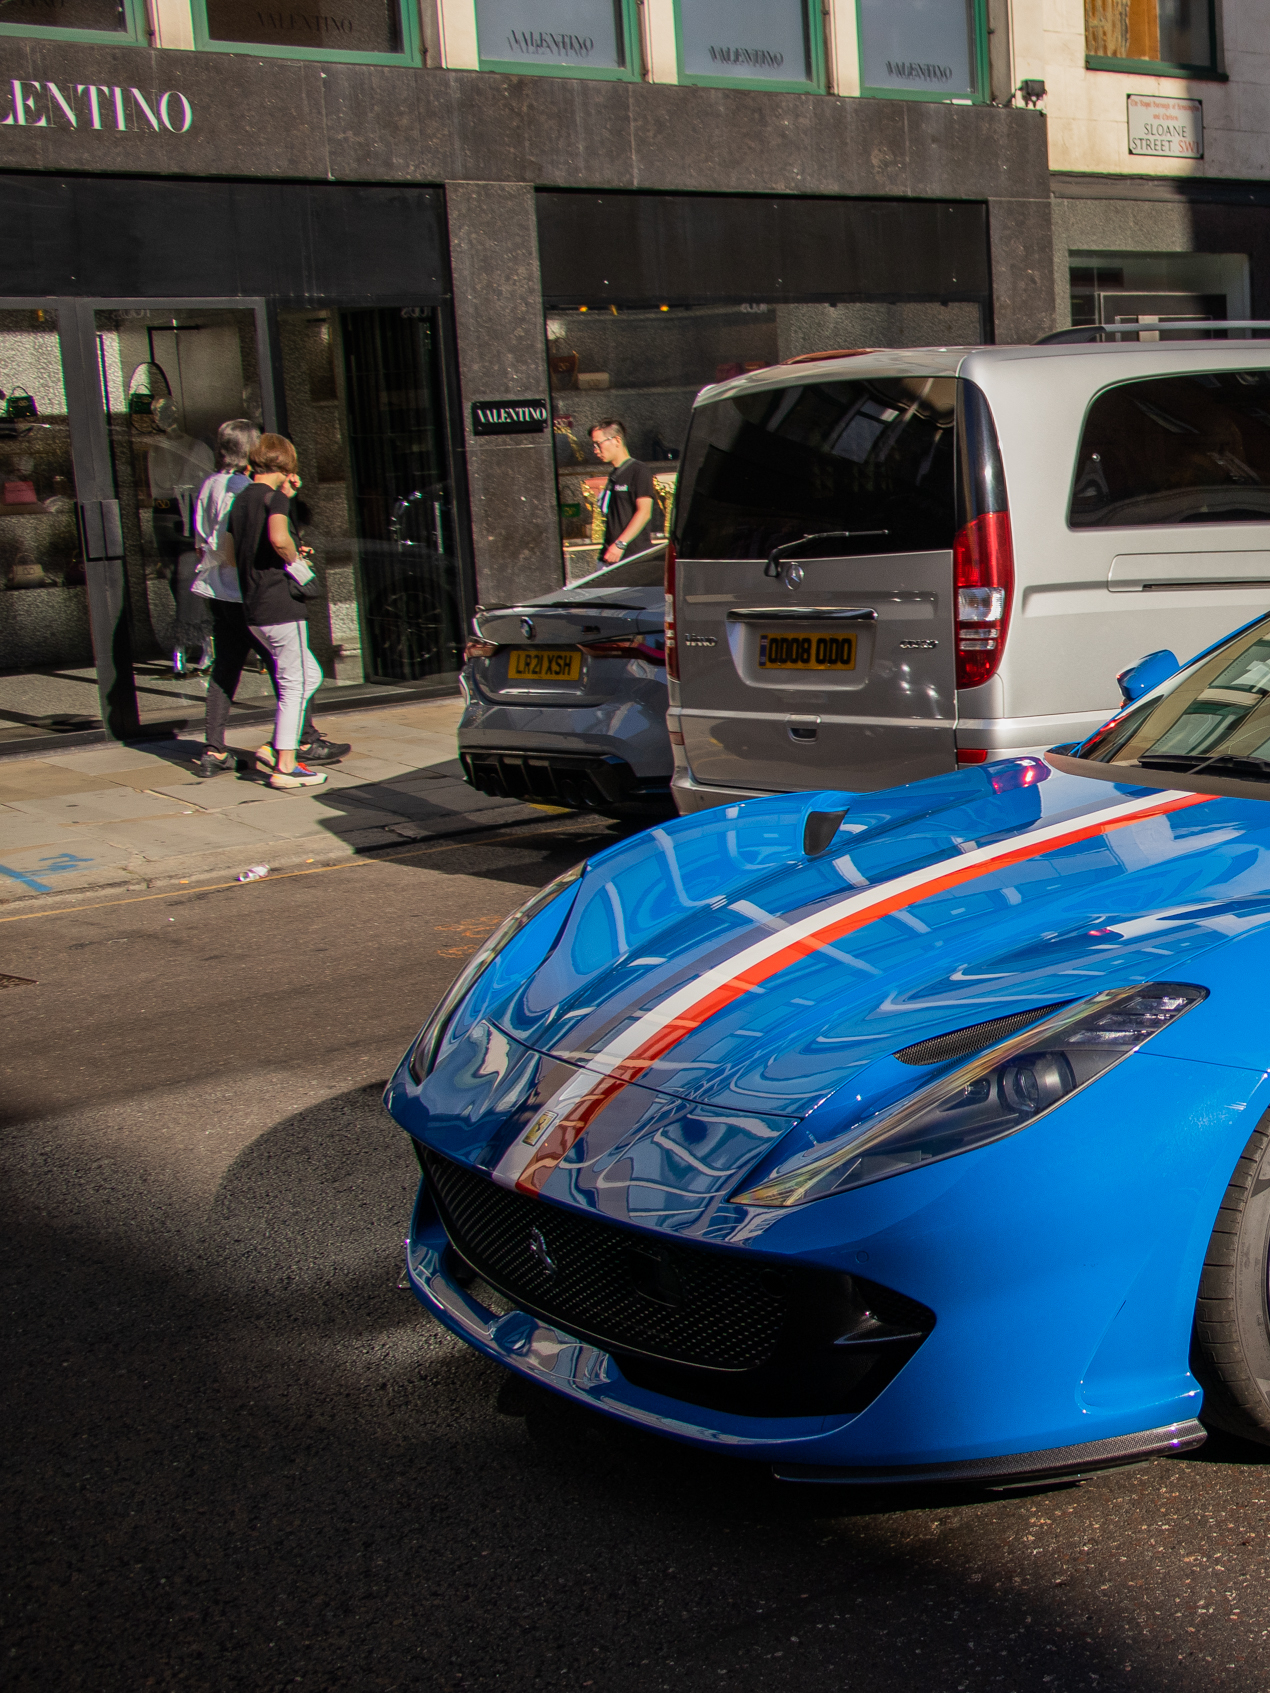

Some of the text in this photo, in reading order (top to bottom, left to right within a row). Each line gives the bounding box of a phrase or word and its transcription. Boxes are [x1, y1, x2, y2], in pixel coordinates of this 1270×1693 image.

[1143, 123, 1187, 138] SLOANE
[477, 407, 547, 424] VALENTINO
[515, 653, 573, 676] LR21 XSH
